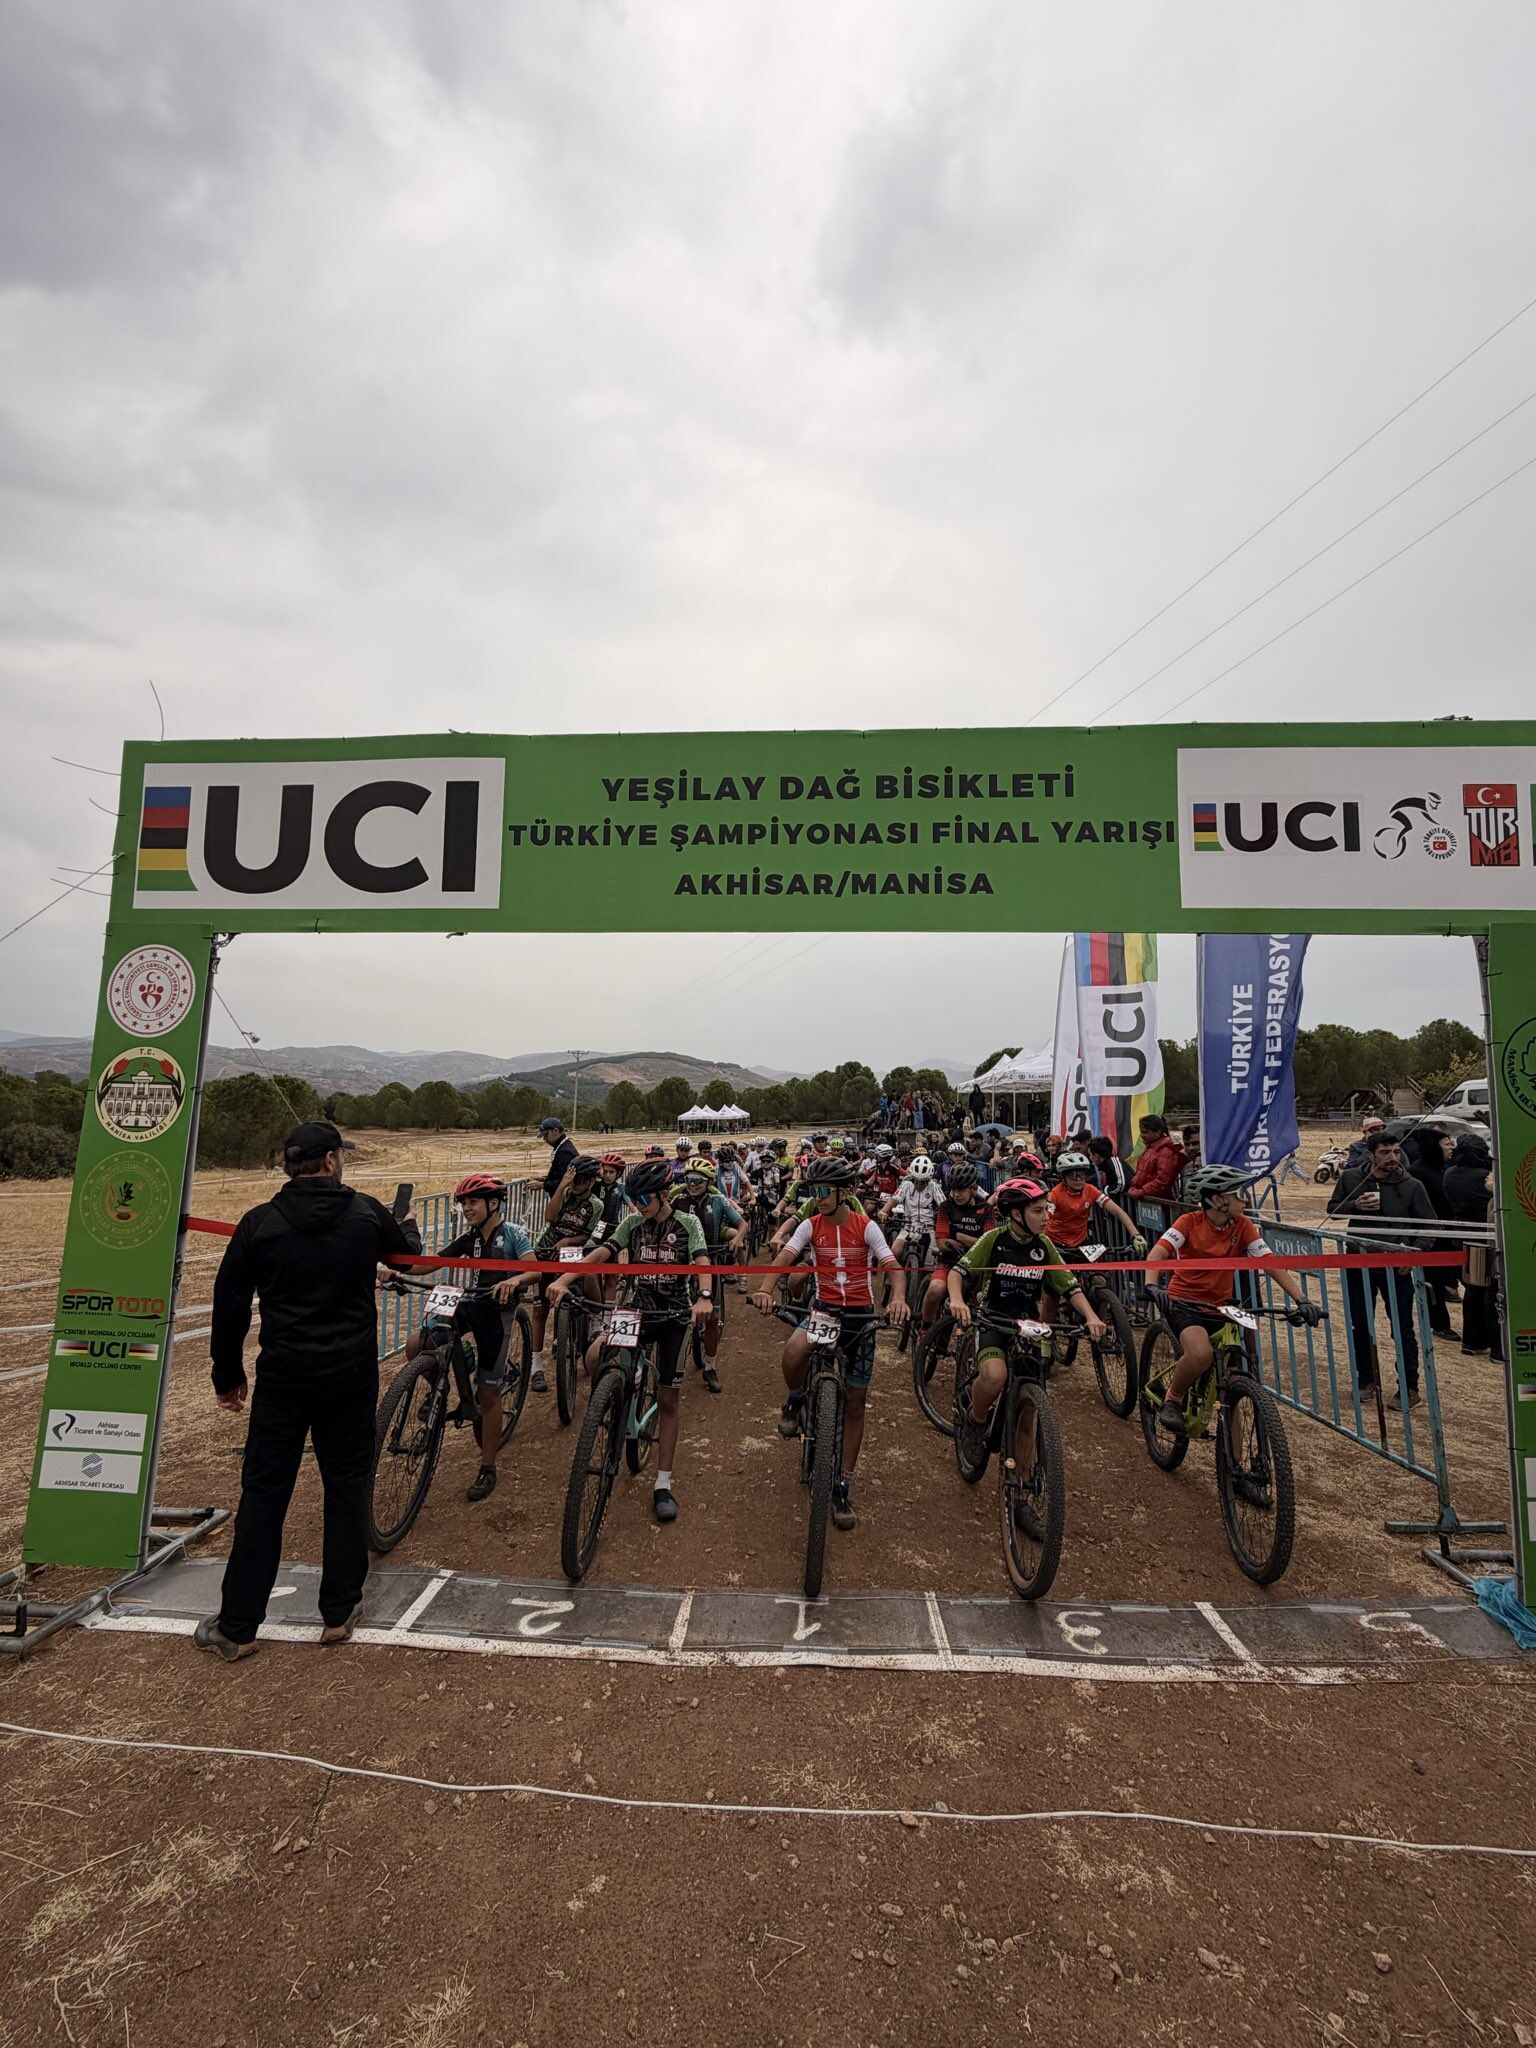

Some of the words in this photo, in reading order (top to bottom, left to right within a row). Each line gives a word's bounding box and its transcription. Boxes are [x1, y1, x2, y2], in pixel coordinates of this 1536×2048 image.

[601, 768, 767, 809] YEŞİLAY
[779, 767, 861, 801] DAĞ
[875, 764, 1075, 800] BİSİKLETİ
[508, 817, 658, 847] TÜRKİYE
[669, 816, 919, 853] ŞAMPİYONASI
[932, 814, 1040, 845] FİNAL
[1051, 820, 1175, 850] YARIŞI
[1224, 801, 1361, 852] UCI
[204, 780, 480, 894] UCI
[673, 866, 995, 898] AKHİSAR/MANİSA
[146, 962, 168, 972] GENÇLİK
[1102, 991, 1147, 1088] UCI
[1227, 983, 1253, 1094] TÜRKİYE
[139, 1048, 155, 1056] T.C.
[1507, 1048, 1521, 1094] MANİSA
[105, 1121, 131, 1140] MANİSA
[134, 1122, 168, 1141] VALİLİĞİ
[1165, 1231, 1180, 1242] ride
[429, 1293, 459, 1308] 133
[63, 1328, 87, 1336] CENTRE
[87, 1329, 116, 1337] MONDIAL
[127, 1331, 156, 1339] CYCLISME
[610, 1320, 640, 1337] 131
[808, 1320, 839, 1340] 130
[89, 1341, 128, 1359] UCI
[119, 1363, 142, 1371] CENTRE
[74, 1427, 94, 1435] Ticaret
[103, 1428, 123, 1438] Sanayi
[124, 1430, 141, 1438] Odası
[54, 1479, 78, 1487] AKHİSAR
[79, 1480, 101, 1488] TİCARET
[101, 1481, 125, 1489] BORSASI
[508, 1597, 575, 1636] 2
[775, 1598, 830, 1641] 1
[1056, 1610, 1109, 1655] 3
